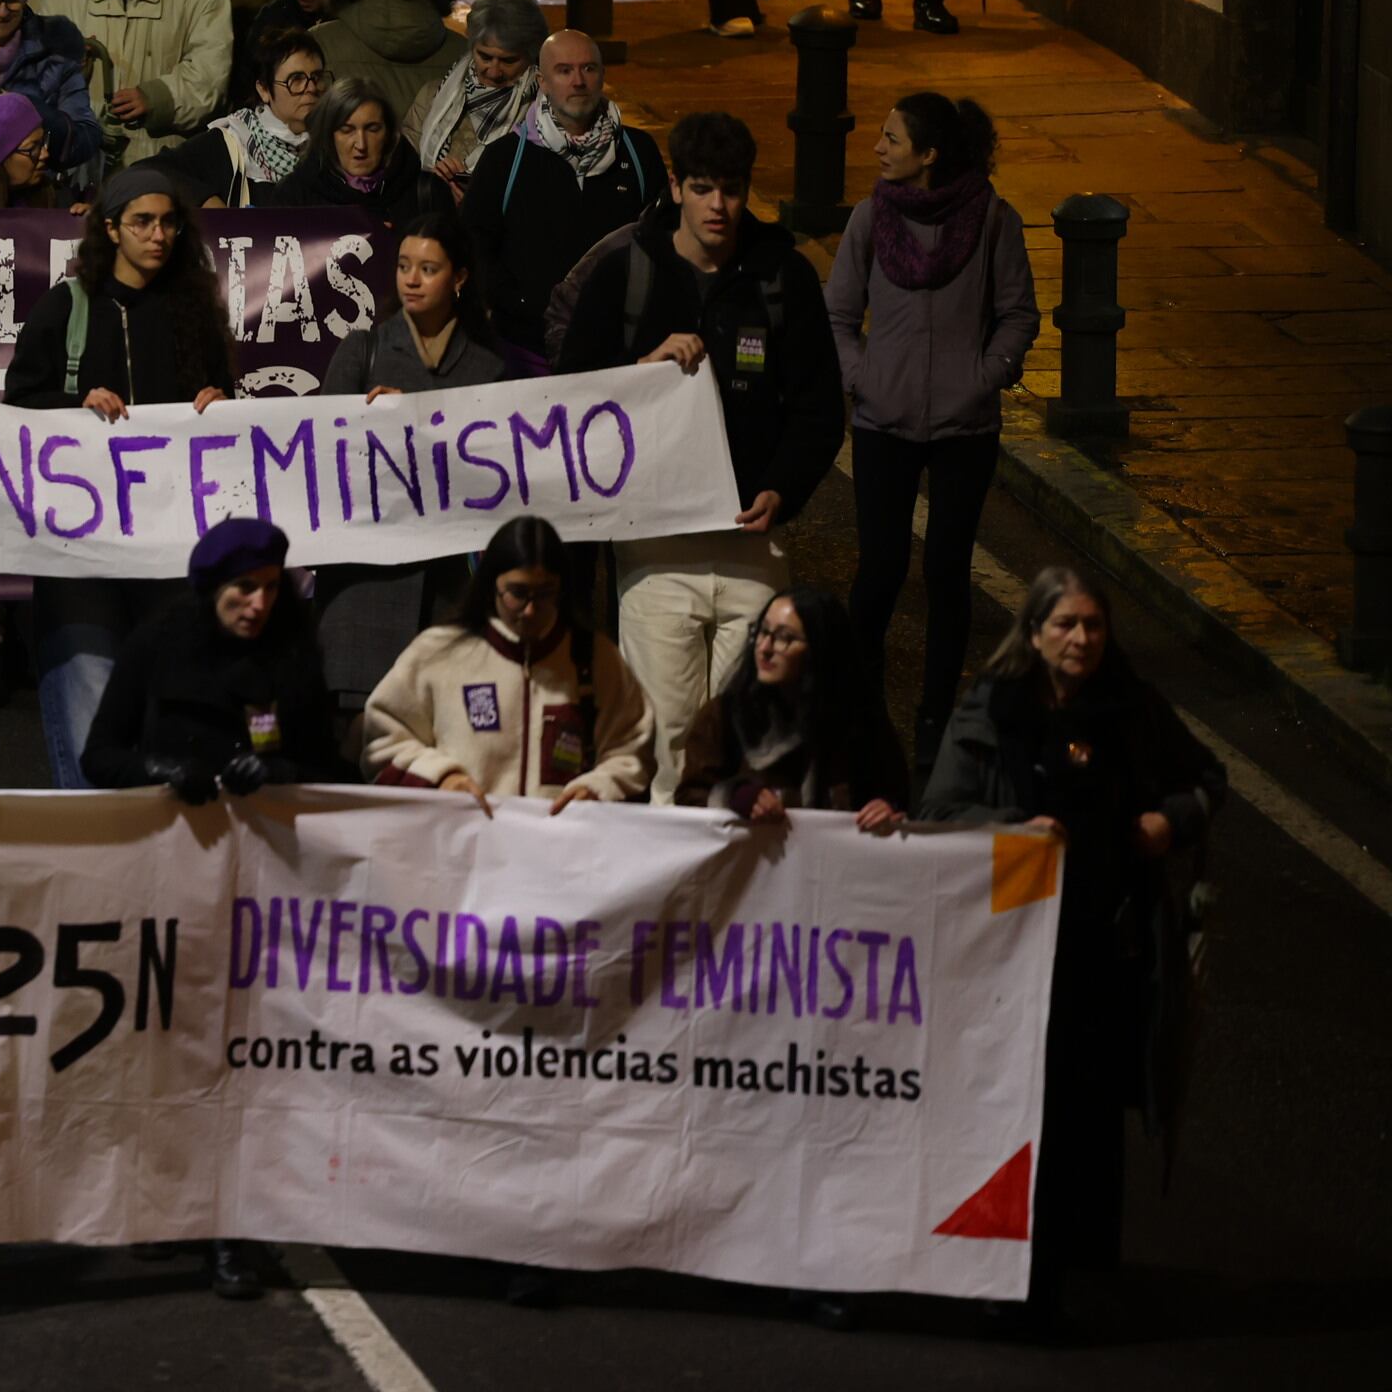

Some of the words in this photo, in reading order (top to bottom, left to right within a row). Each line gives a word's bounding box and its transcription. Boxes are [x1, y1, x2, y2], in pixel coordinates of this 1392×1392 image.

[228, 897, 602, 1009] DIVERSIDADE
[629, 921, 923, 1026] FEMINISTA
[227, 1030, 376, 1074] contra
[389, 1043, 440, 1076] as
[455, 1026, 679, 1085] violencias
[693, 1042, 922, 1102] machistas
